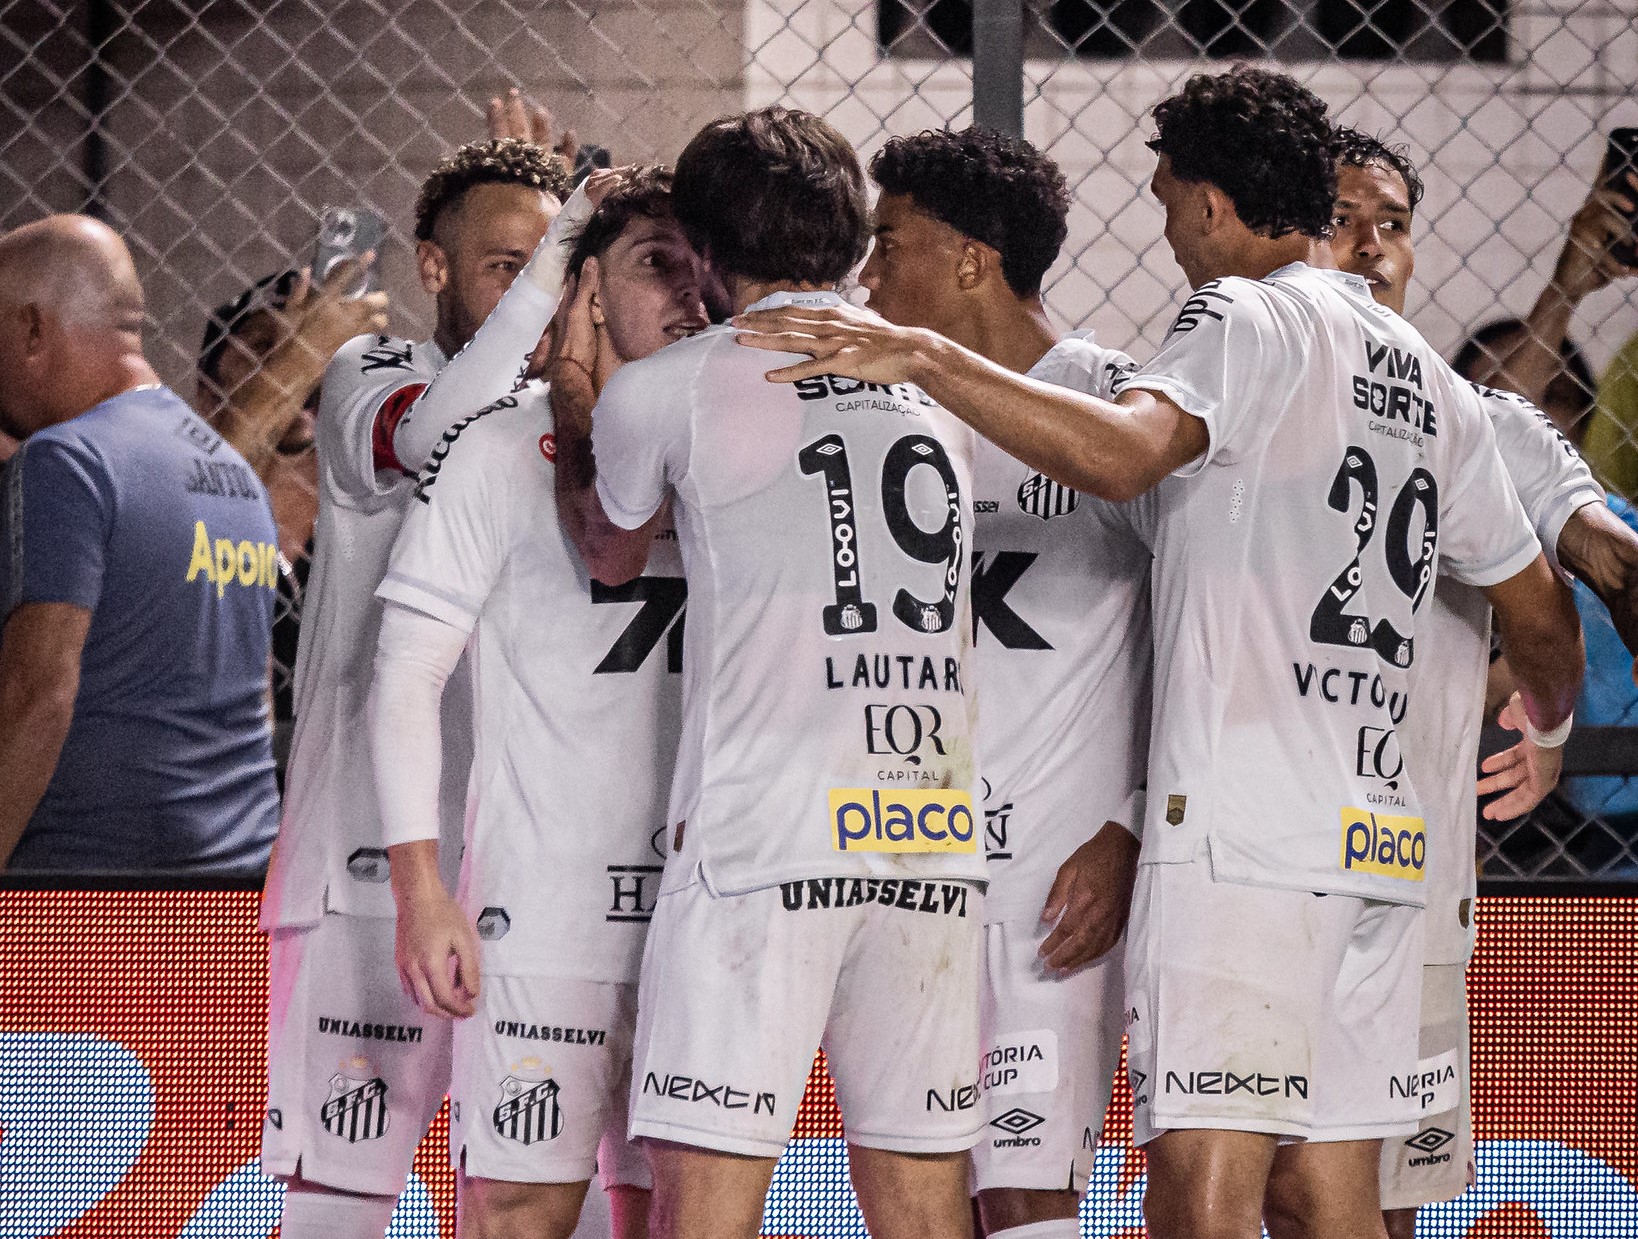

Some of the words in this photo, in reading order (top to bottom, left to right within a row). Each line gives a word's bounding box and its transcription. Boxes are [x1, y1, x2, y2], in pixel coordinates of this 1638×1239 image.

[1364, 339, 1423, 391] VIVA
[1352, 375, 1437, 438] SORTE
[798, 434, 963, 635] 19
[830, 488, 858, 588] LOOVI
[825, 653, 964, 696] LAUTAR
[864, 704, 948, 766] EQR
[1356, 725, 1404, 791] EQ
[877, 770, 939, 781] CAPITAL
[1366, 792, 1406, 807] CAPITAL
[836, 790, 974, 850] placo
[1345, 812, 1426, 870] placo
[319, 1016, 423, 1043] UNIASSELVI
[494, 1020, 606, 1046] UNIASSELVI
[993, 1135, 1041, 1149] umbro
[1408, 1152, 1451, 1168] umbro
